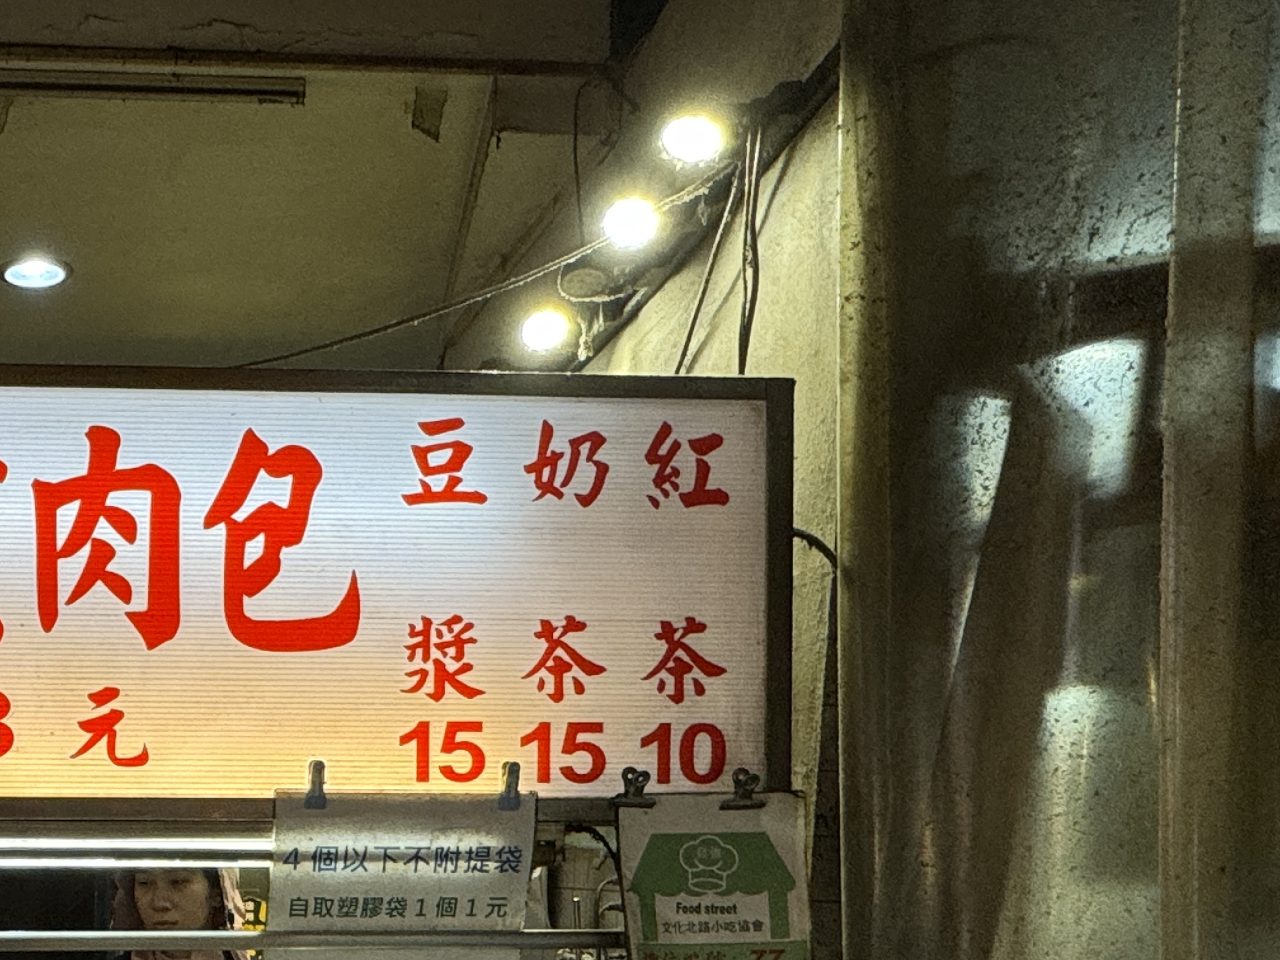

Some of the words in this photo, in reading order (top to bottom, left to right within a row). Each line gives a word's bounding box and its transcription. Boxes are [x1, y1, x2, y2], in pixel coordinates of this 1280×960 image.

[521, 419, 610, 703] 奶茶
[640, 420, 730, 704] 紅茶
[399, 721, 486, 783] 15
[520, 721, 607, 784] 15
[640, 722, 726, 784] 10
[675, 902, 701, 915] Food
[704, 903, 738, 915] street
